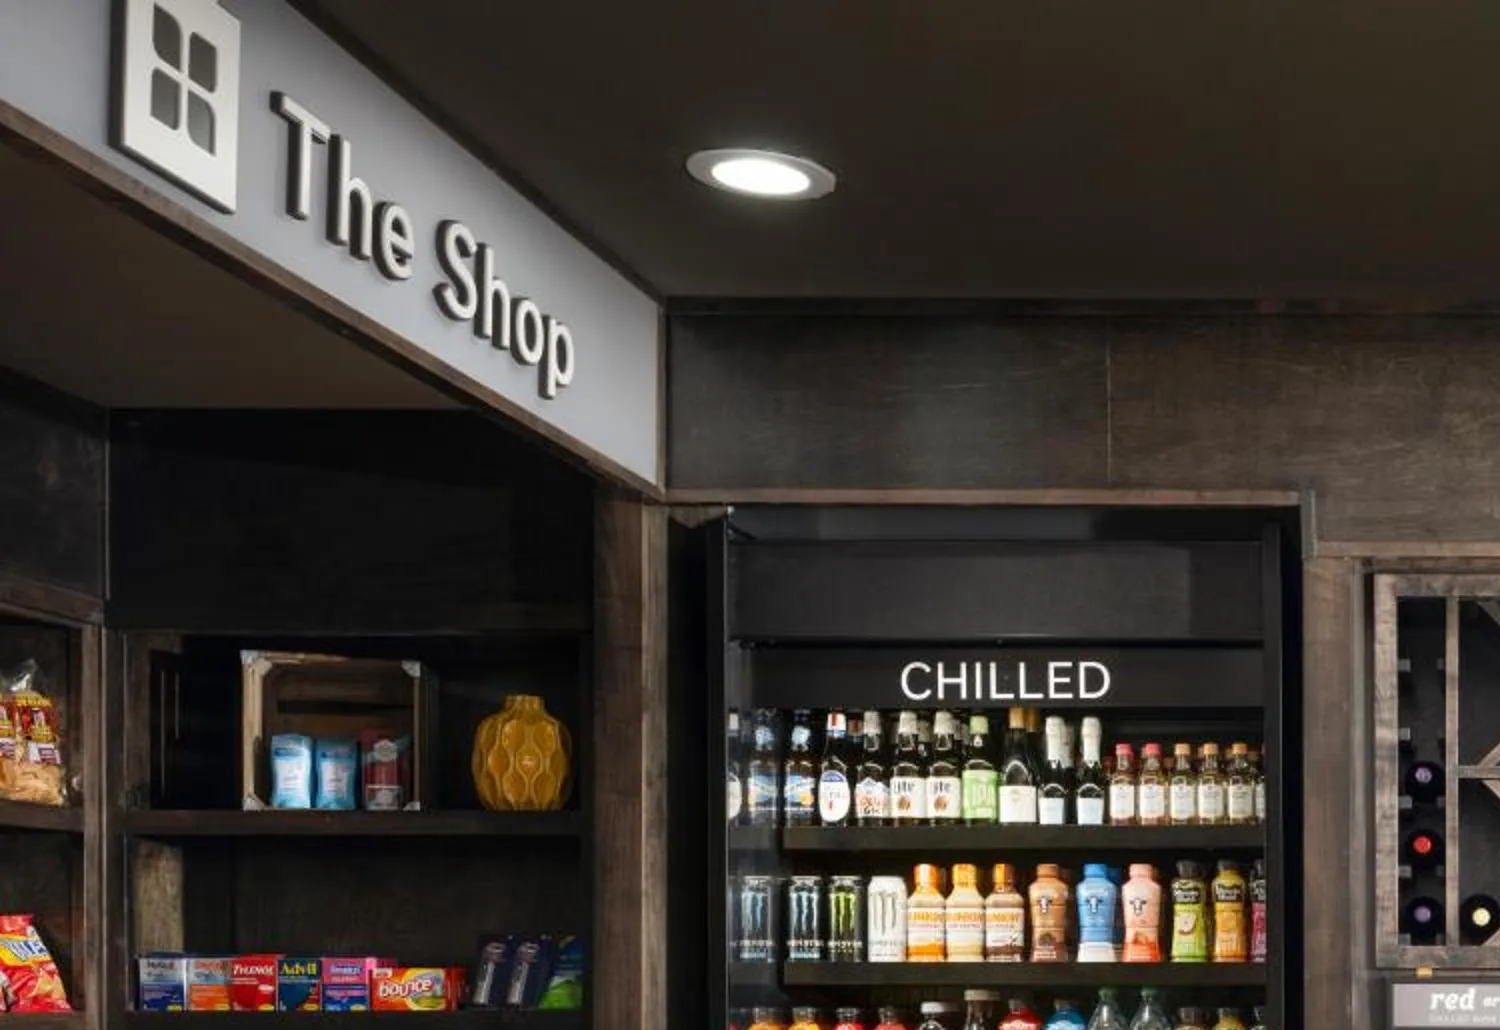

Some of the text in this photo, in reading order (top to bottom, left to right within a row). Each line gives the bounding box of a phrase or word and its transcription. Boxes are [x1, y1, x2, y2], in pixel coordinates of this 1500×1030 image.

[270, 91, 575, 399] The Shop
[899, 660, 1112, 701] CHILLED
[378, 976, 433, 998] bounce
[1429, 987, 1477, 1011] red
